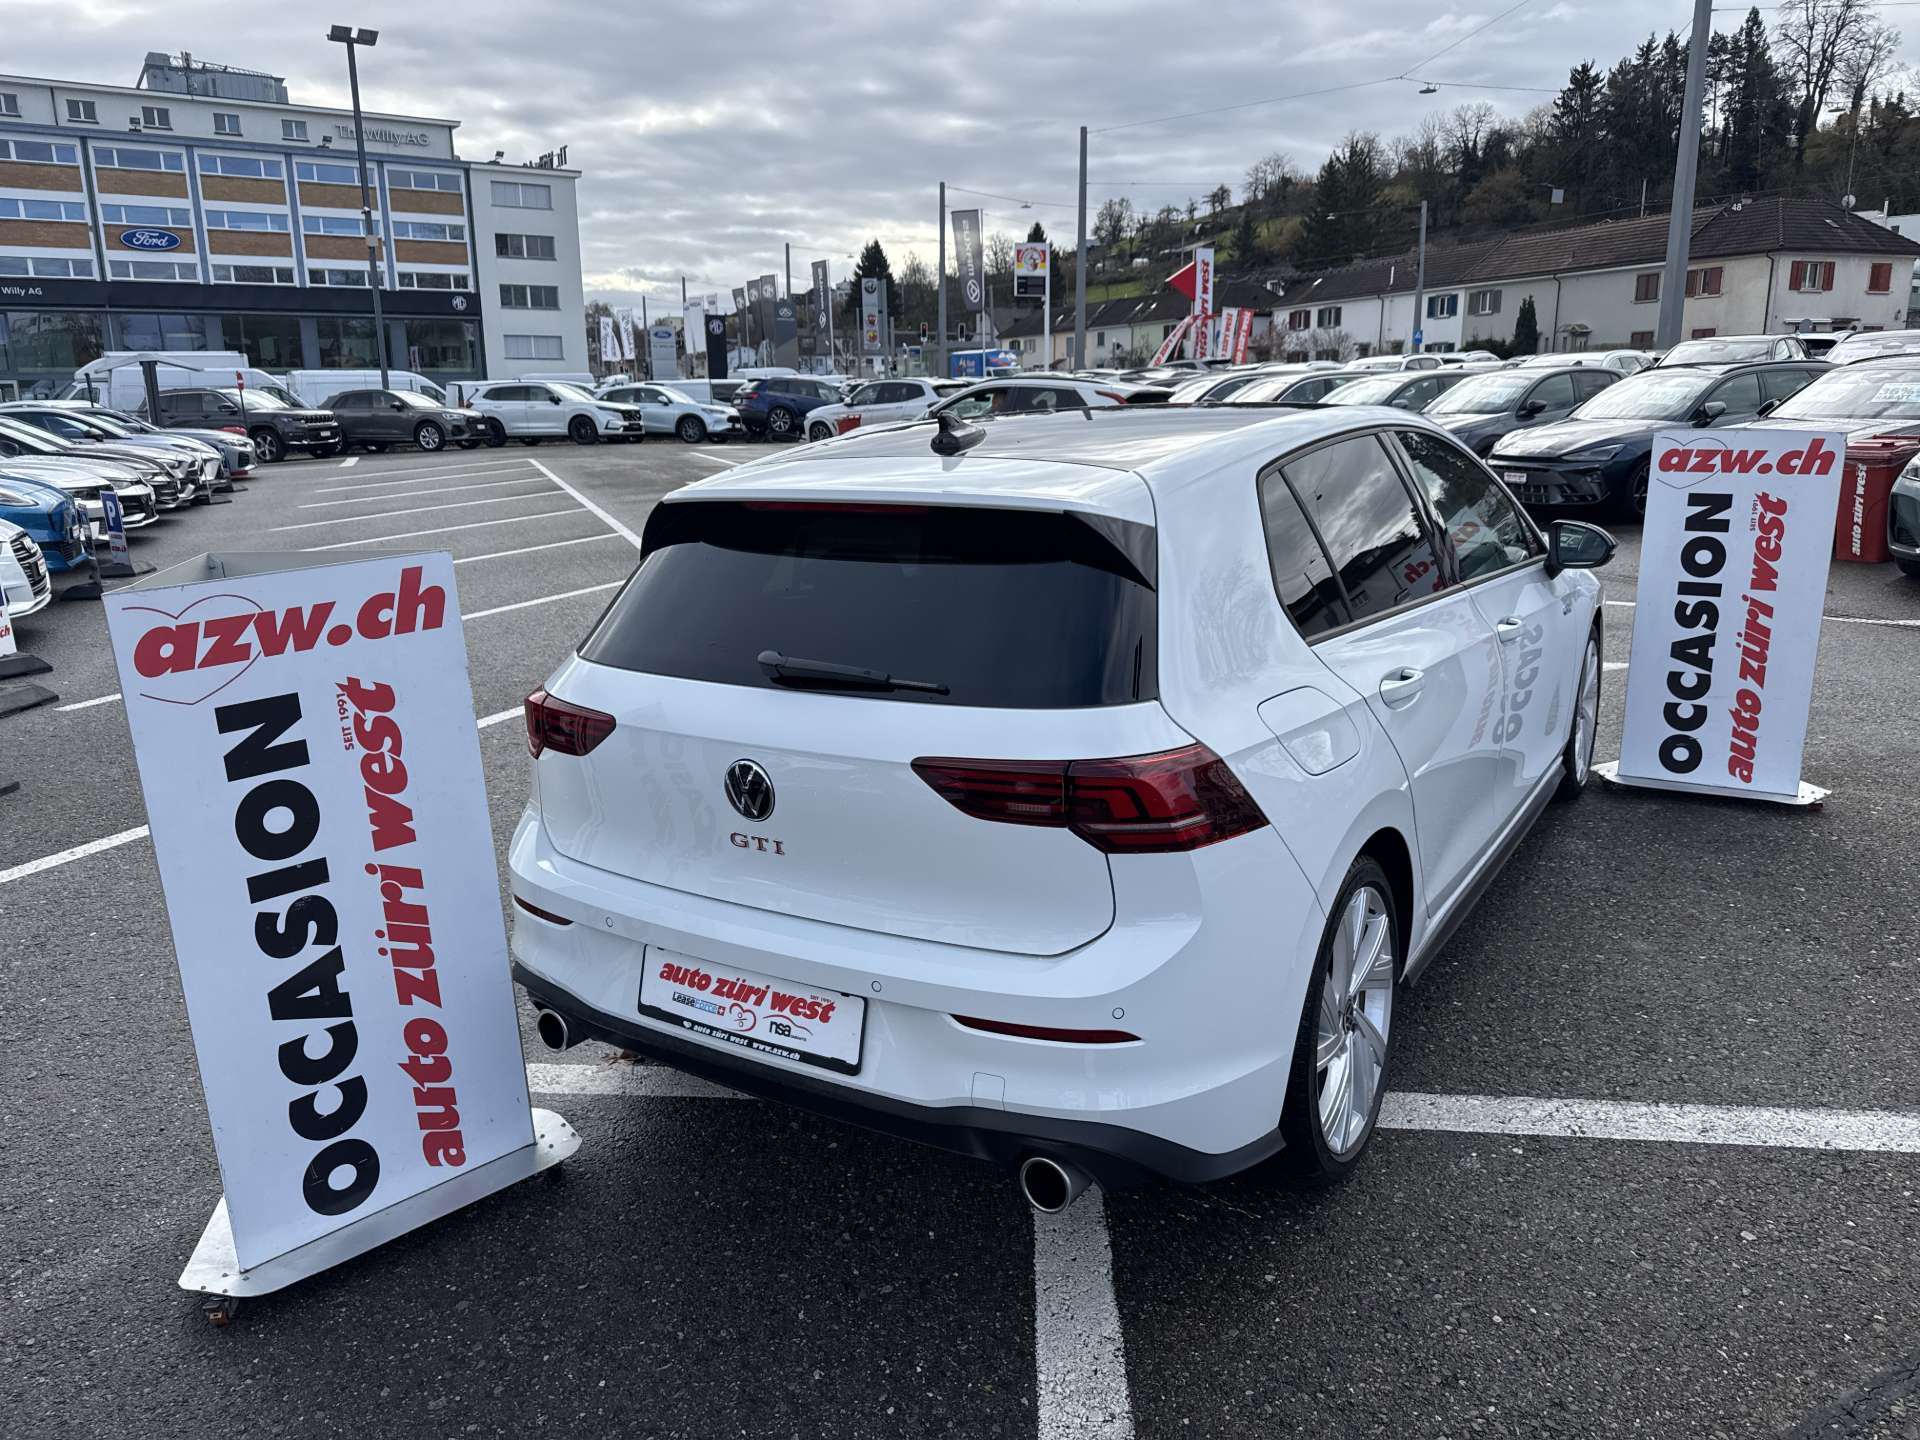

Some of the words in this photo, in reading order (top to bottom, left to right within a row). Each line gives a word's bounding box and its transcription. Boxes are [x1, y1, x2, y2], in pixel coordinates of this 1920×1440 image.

[406, 131, 430, 146] AG
[1, 286, 25, 297] Willy
[28, 287, 43, 296] AG
[1658, 438, 1836, 476] azw.ch
[1855, 463, 1867, 494] west
[1750, 491, 1788, 592] west
[133, 566, 446, 678] azw.ch
[1658, 492, 1734, 775] OCCASION
[1735, 593, 1774, 690] züri
[336, 693, 349, 721] 1991
[1728, 688, 1762, 785] auto
[336, 676, 417, 851] west
[341, 726, 355, 751] SEIT
[730, 832, 785, 856] GTI
[215, 692, 381, 1216] OCCASION
[365, 863, 442, 1009] züri
[659, 963, 712, 992] auto
[710, 977, 771, 1007] züri
[770, 991, 836, 1024] west
[693, 1024, 710, 1035] auto
[729, 1035, 749, 1046] west
[752, 1042, 800, 1061] www.azw.ch
[769, 1021, 791, 1038] nsa
[397, 1017, 466, 1167] auto
